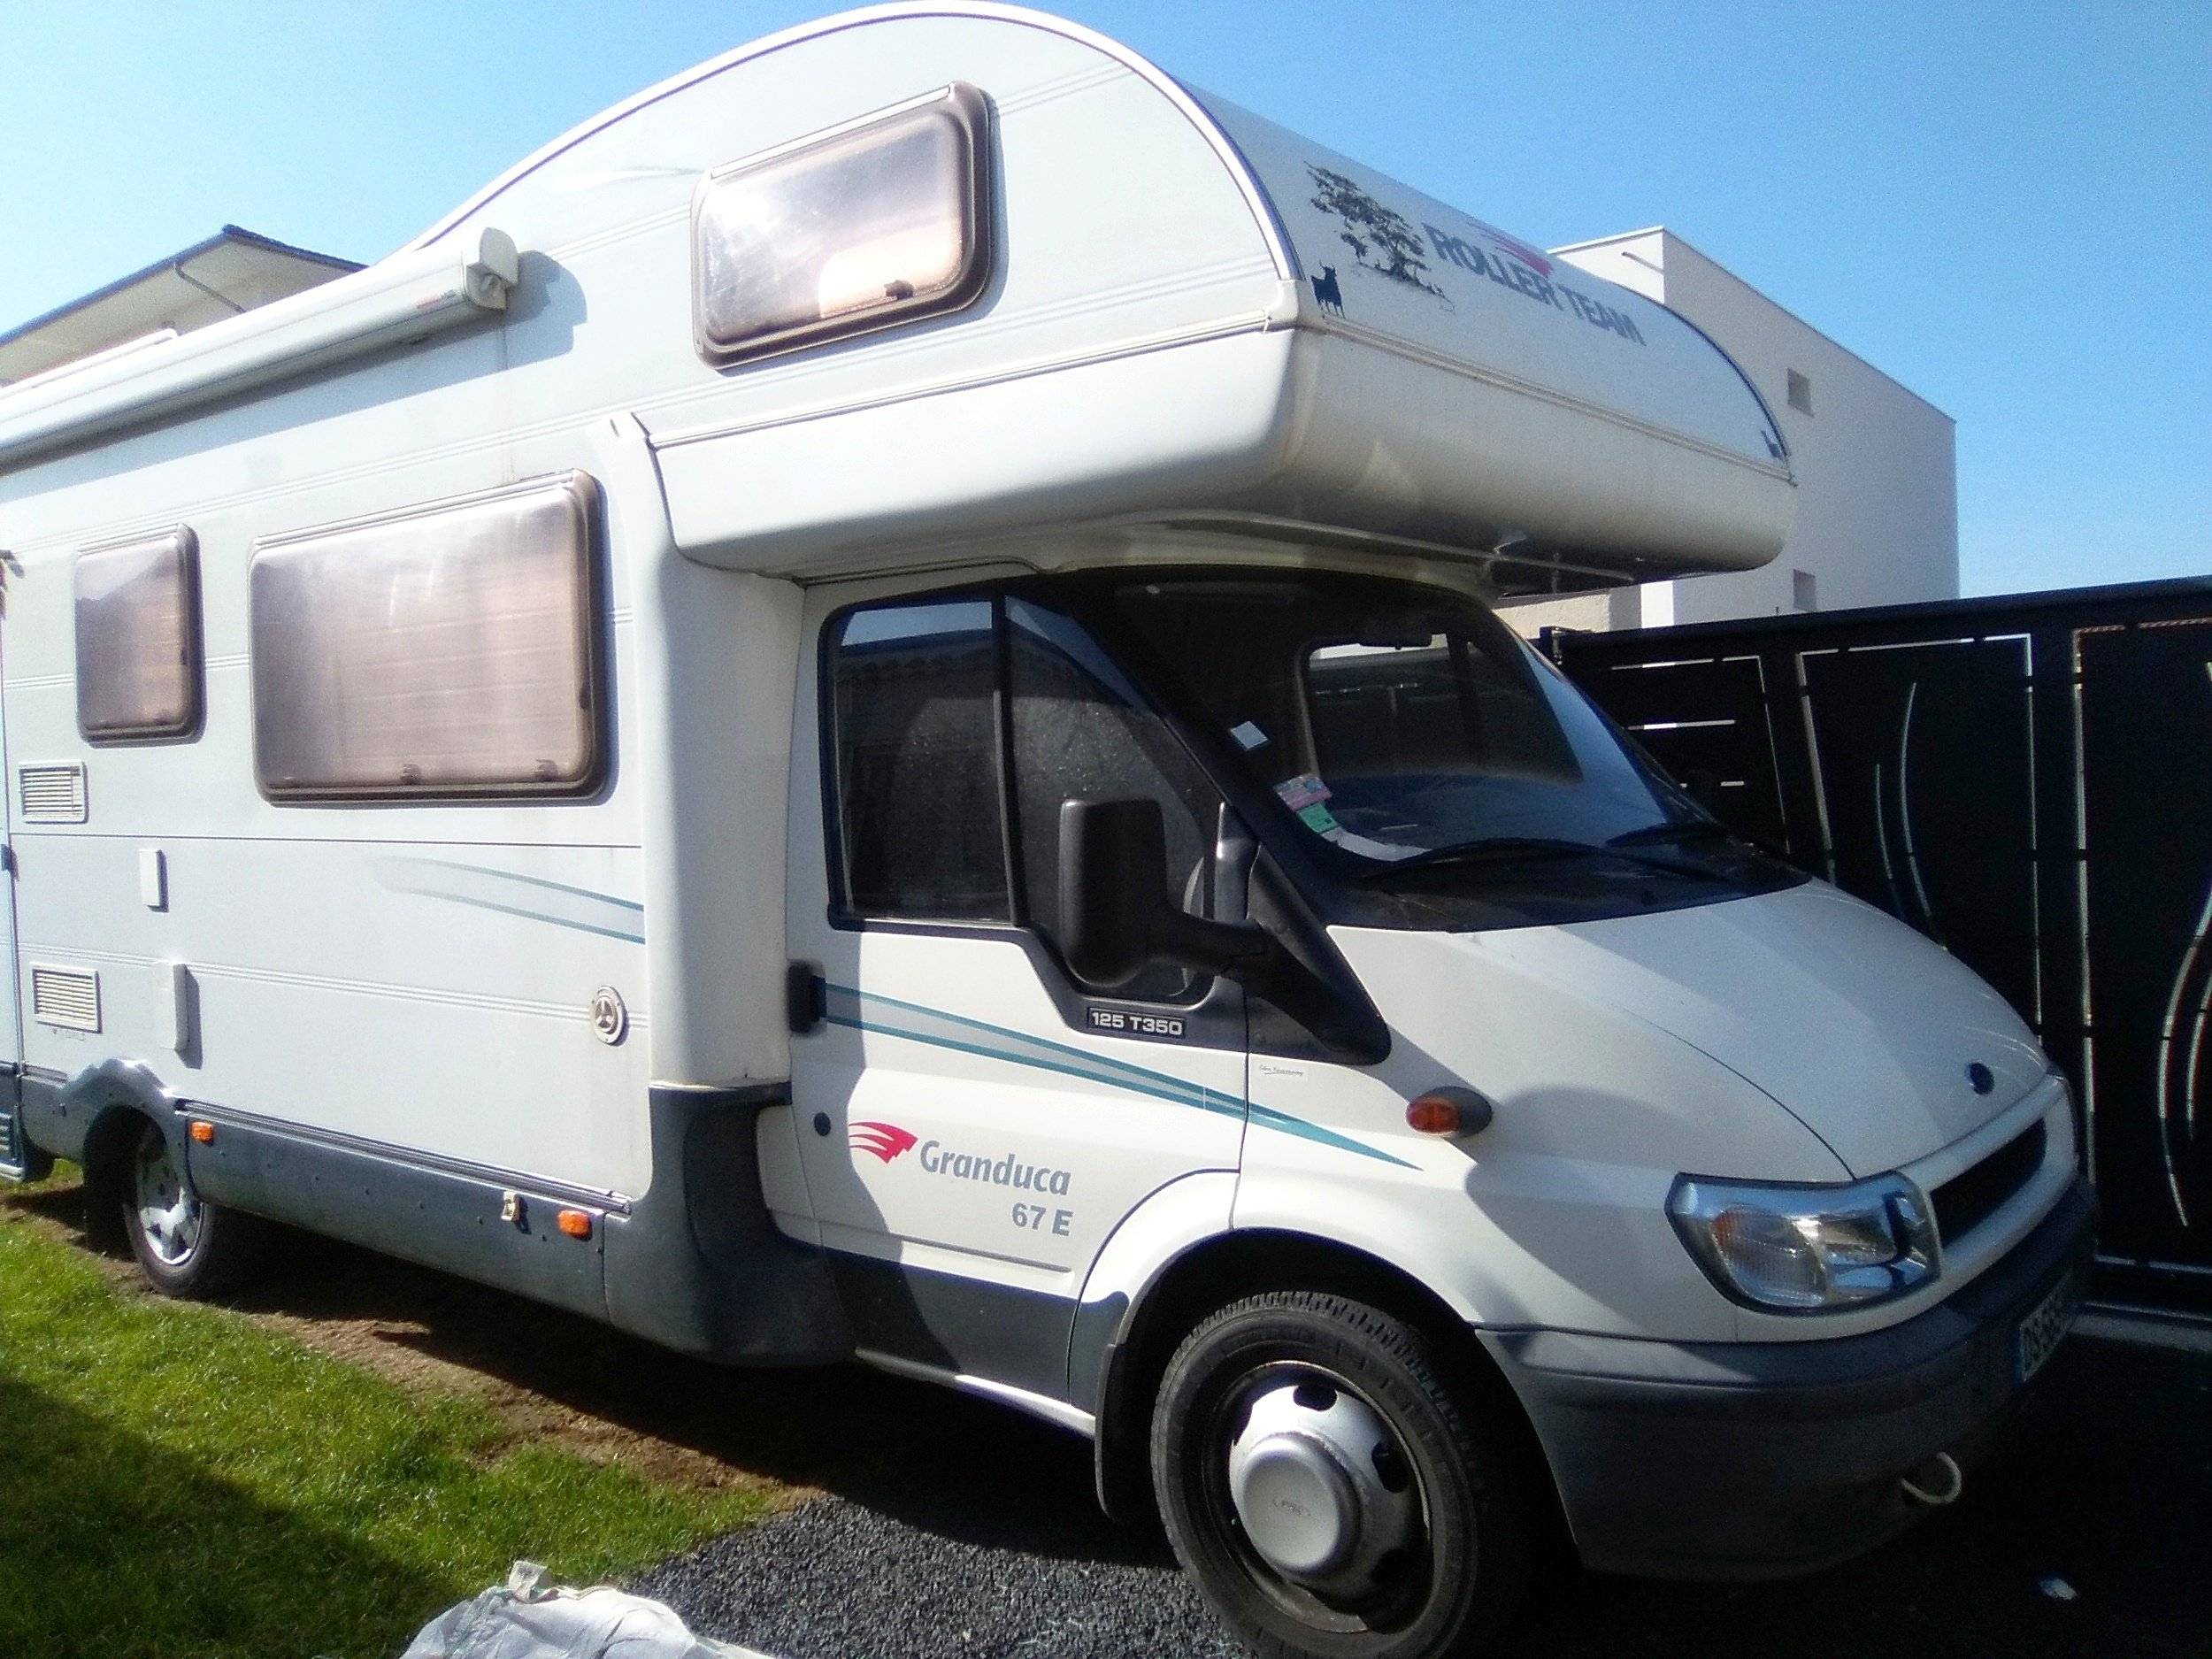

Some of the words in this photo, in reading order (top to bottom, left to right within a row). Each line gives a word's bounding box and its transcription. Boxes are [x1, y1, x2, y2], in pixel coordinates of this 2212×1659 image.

[1421, 222, 1564, 311] ROLLER
[1555, 282, 1647, 347] TEAM
[1092, 1011, 1125, 1029] 125
[1129, 1016, 1183, 1035] T350
[920, 1140, 1071, 1195] Granduca
[1012, 1202, 1047, 1231] 67
[1051, 1209, 1073, 1237] E
